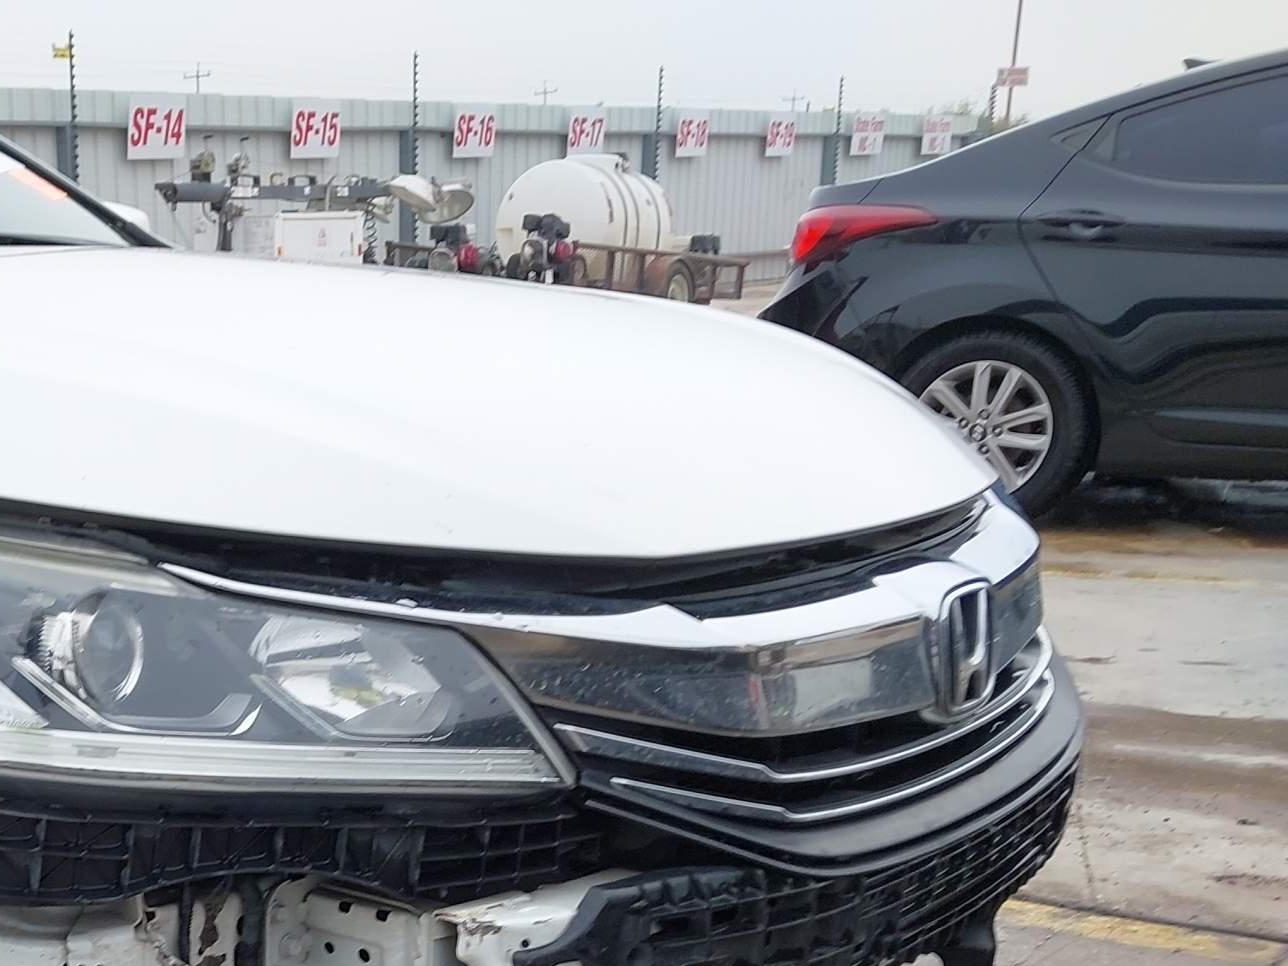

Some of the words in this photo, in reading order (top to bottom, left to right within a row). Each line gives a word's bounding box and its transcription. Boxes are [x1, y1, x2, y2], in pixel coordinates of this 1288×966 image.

[130, 107, 184, 146] SF-14
[293, 110, 339, 146] SF-15
[455, 114, 495, 147] SF-16
[569, 117, 604, 147] SF-17
[679, 119, 707, 147] SF-18
